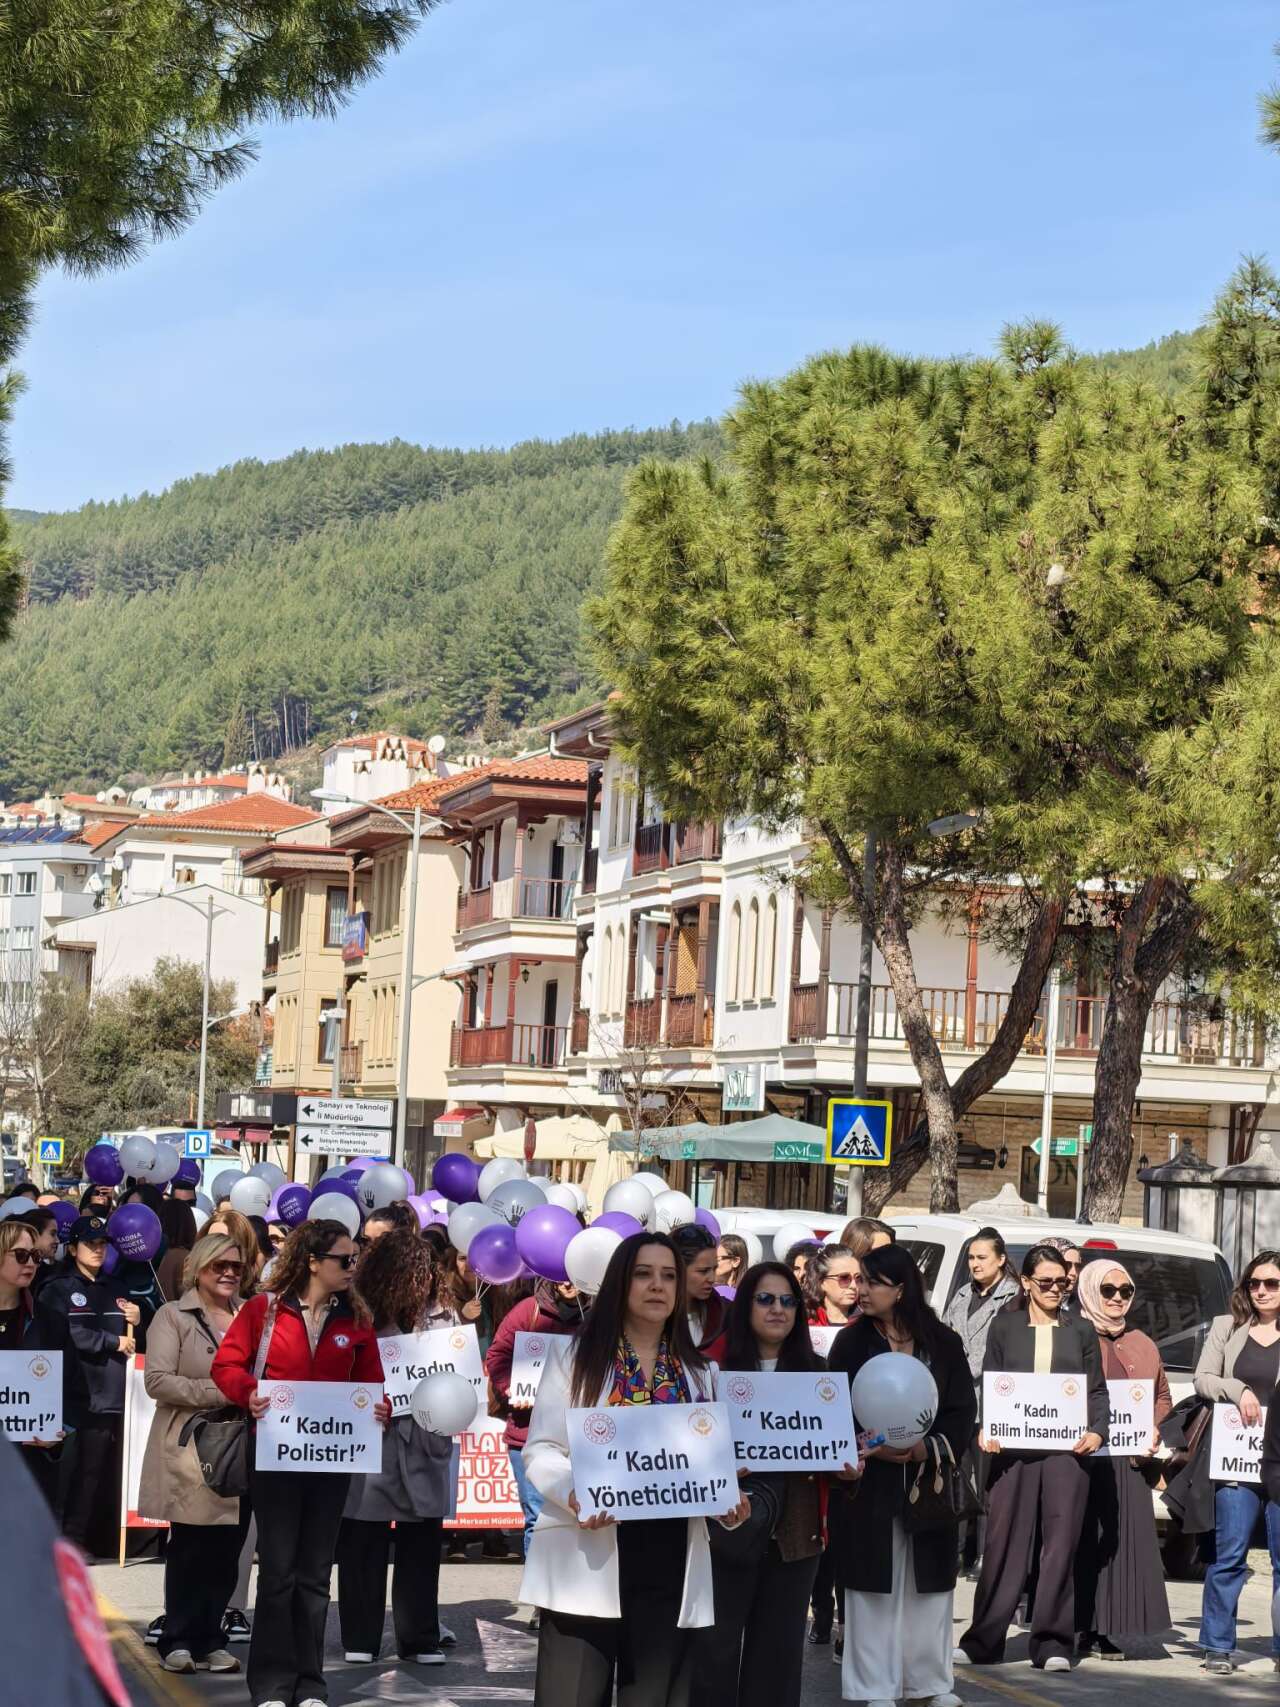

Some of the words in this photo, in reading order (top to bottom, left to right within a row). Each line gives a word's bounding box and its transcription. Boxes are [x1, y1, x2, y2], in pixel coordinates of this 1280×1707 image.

[356, 1103, 388, 1112] Teknoloji
[324, 1113, 363, 1122] Müdürlüğü
[193, 1137, 202, 1151] D
[0, 1386, 30, 1404] dın
[1024, 1402, 1058, 1418] Kadın
[297, 1417, 353, 1435] Kadın
[760, 1410, 822, 1430] Kadın
[990, 1423, 1020, 1437] Bilim
[460, 1432, 508, 1455] LA
[734, 1440, 848, 1460] Eczacıdır!”
[278, 1444, 366, 1462] Polistir!”
[626, 1448, 689, 1472] Kadın
[588, 1479, 727, 1508] Yöneticidir!”
